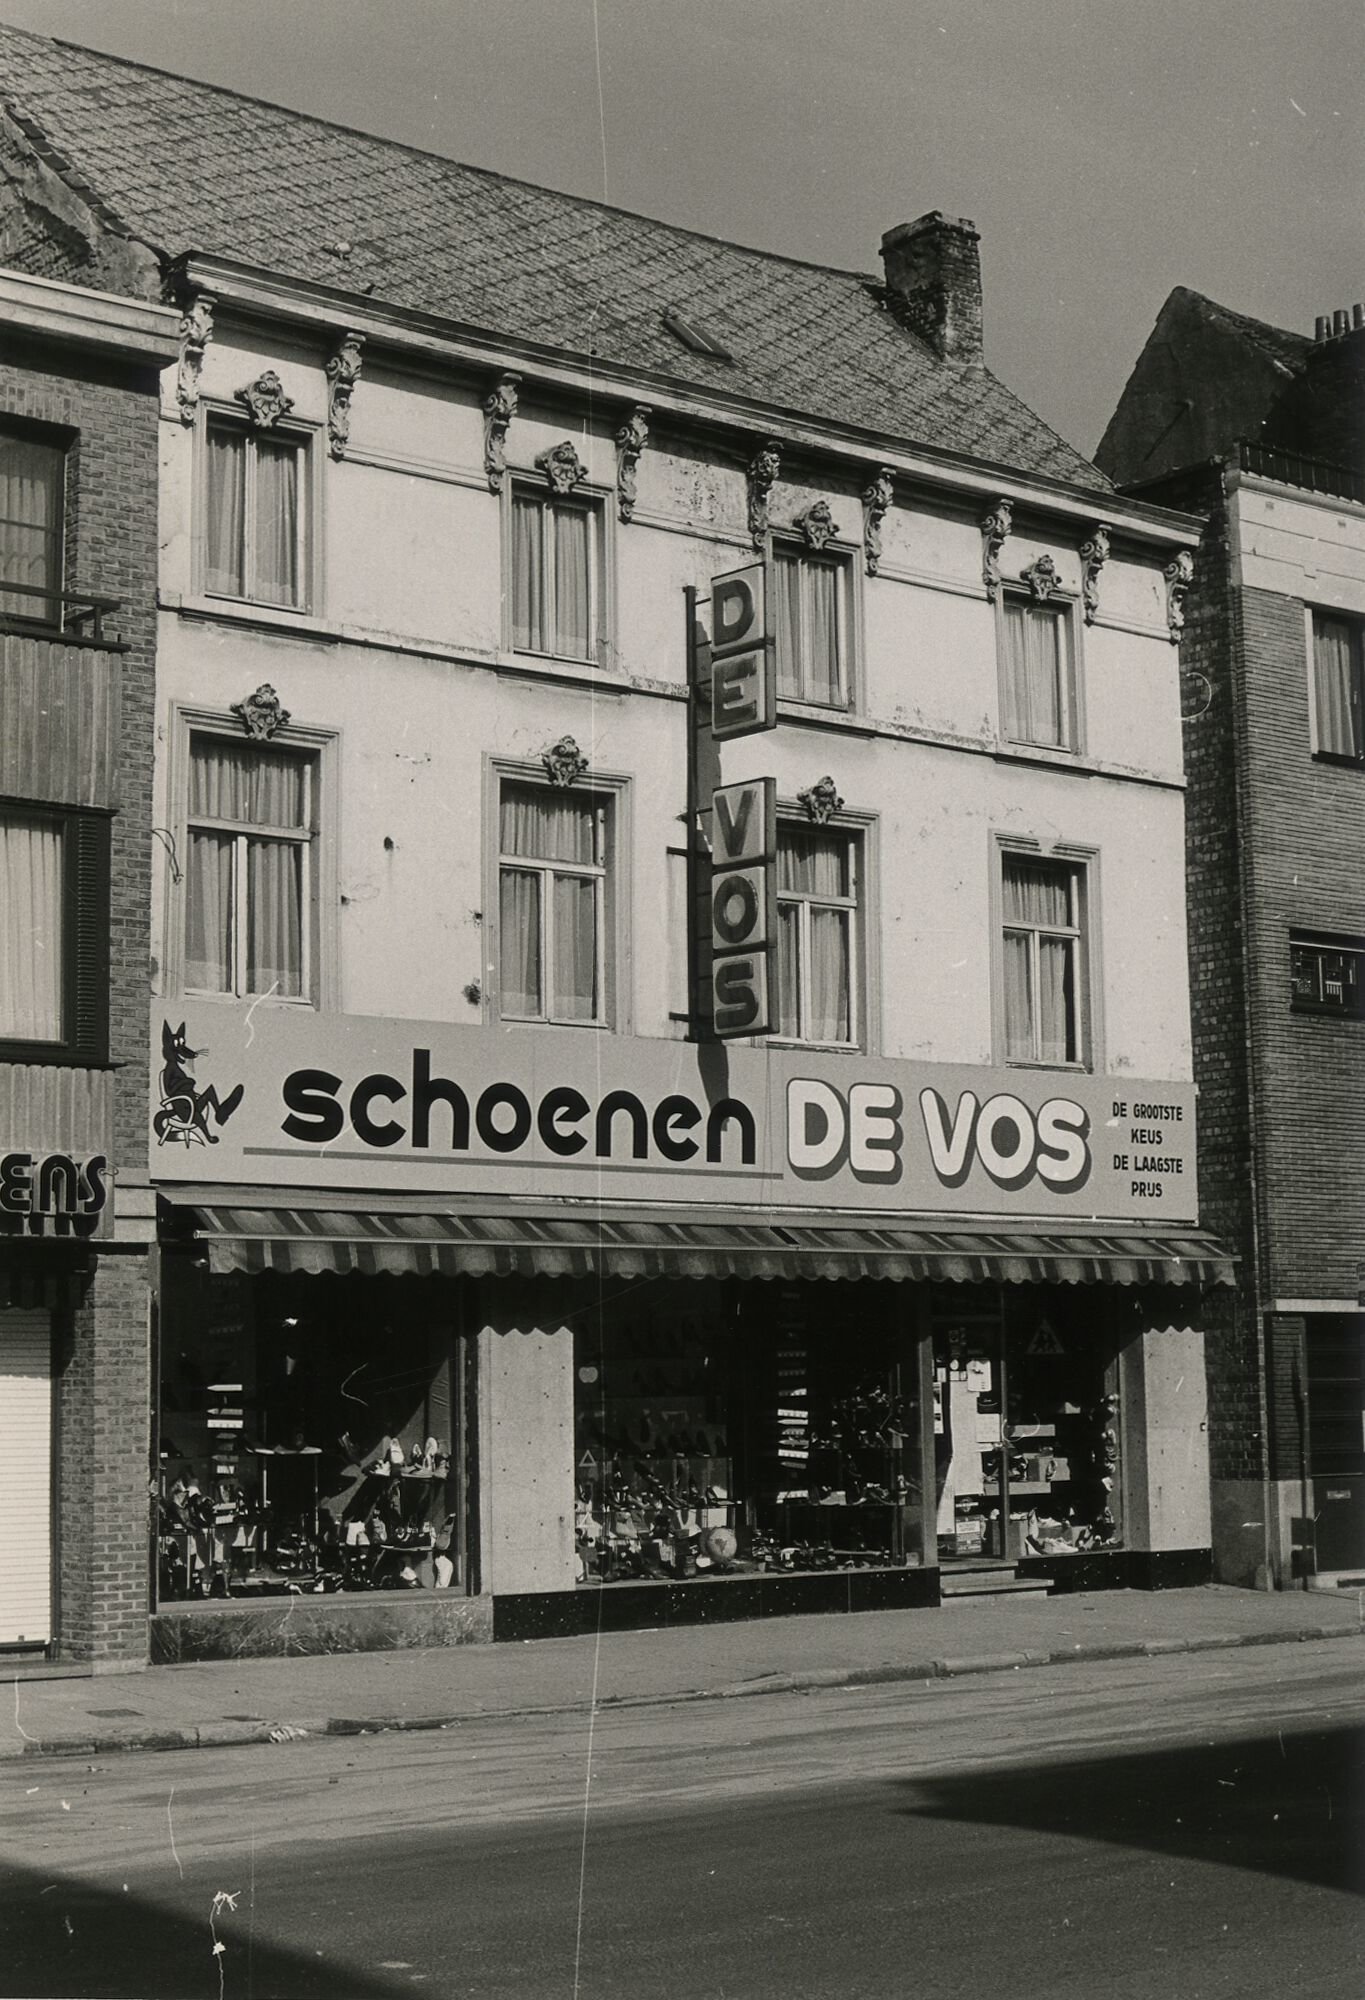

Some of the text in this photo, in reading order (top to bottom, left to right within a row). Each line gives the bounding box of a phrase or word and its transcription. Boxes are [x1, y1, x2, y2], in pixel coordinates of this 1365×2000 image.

[712, 577, 758, 726] DE
[713, 789, 759, 1028] VOS
[281, 1048, 1091, 1195] schoenen DE VOS
[1112, 1101, 1183, 1121] DE GROOTSTE
[1131, 1128, 1163, 1145] KEUS
[1113, 1154, 1183, 1174] DE LAAGSTE
